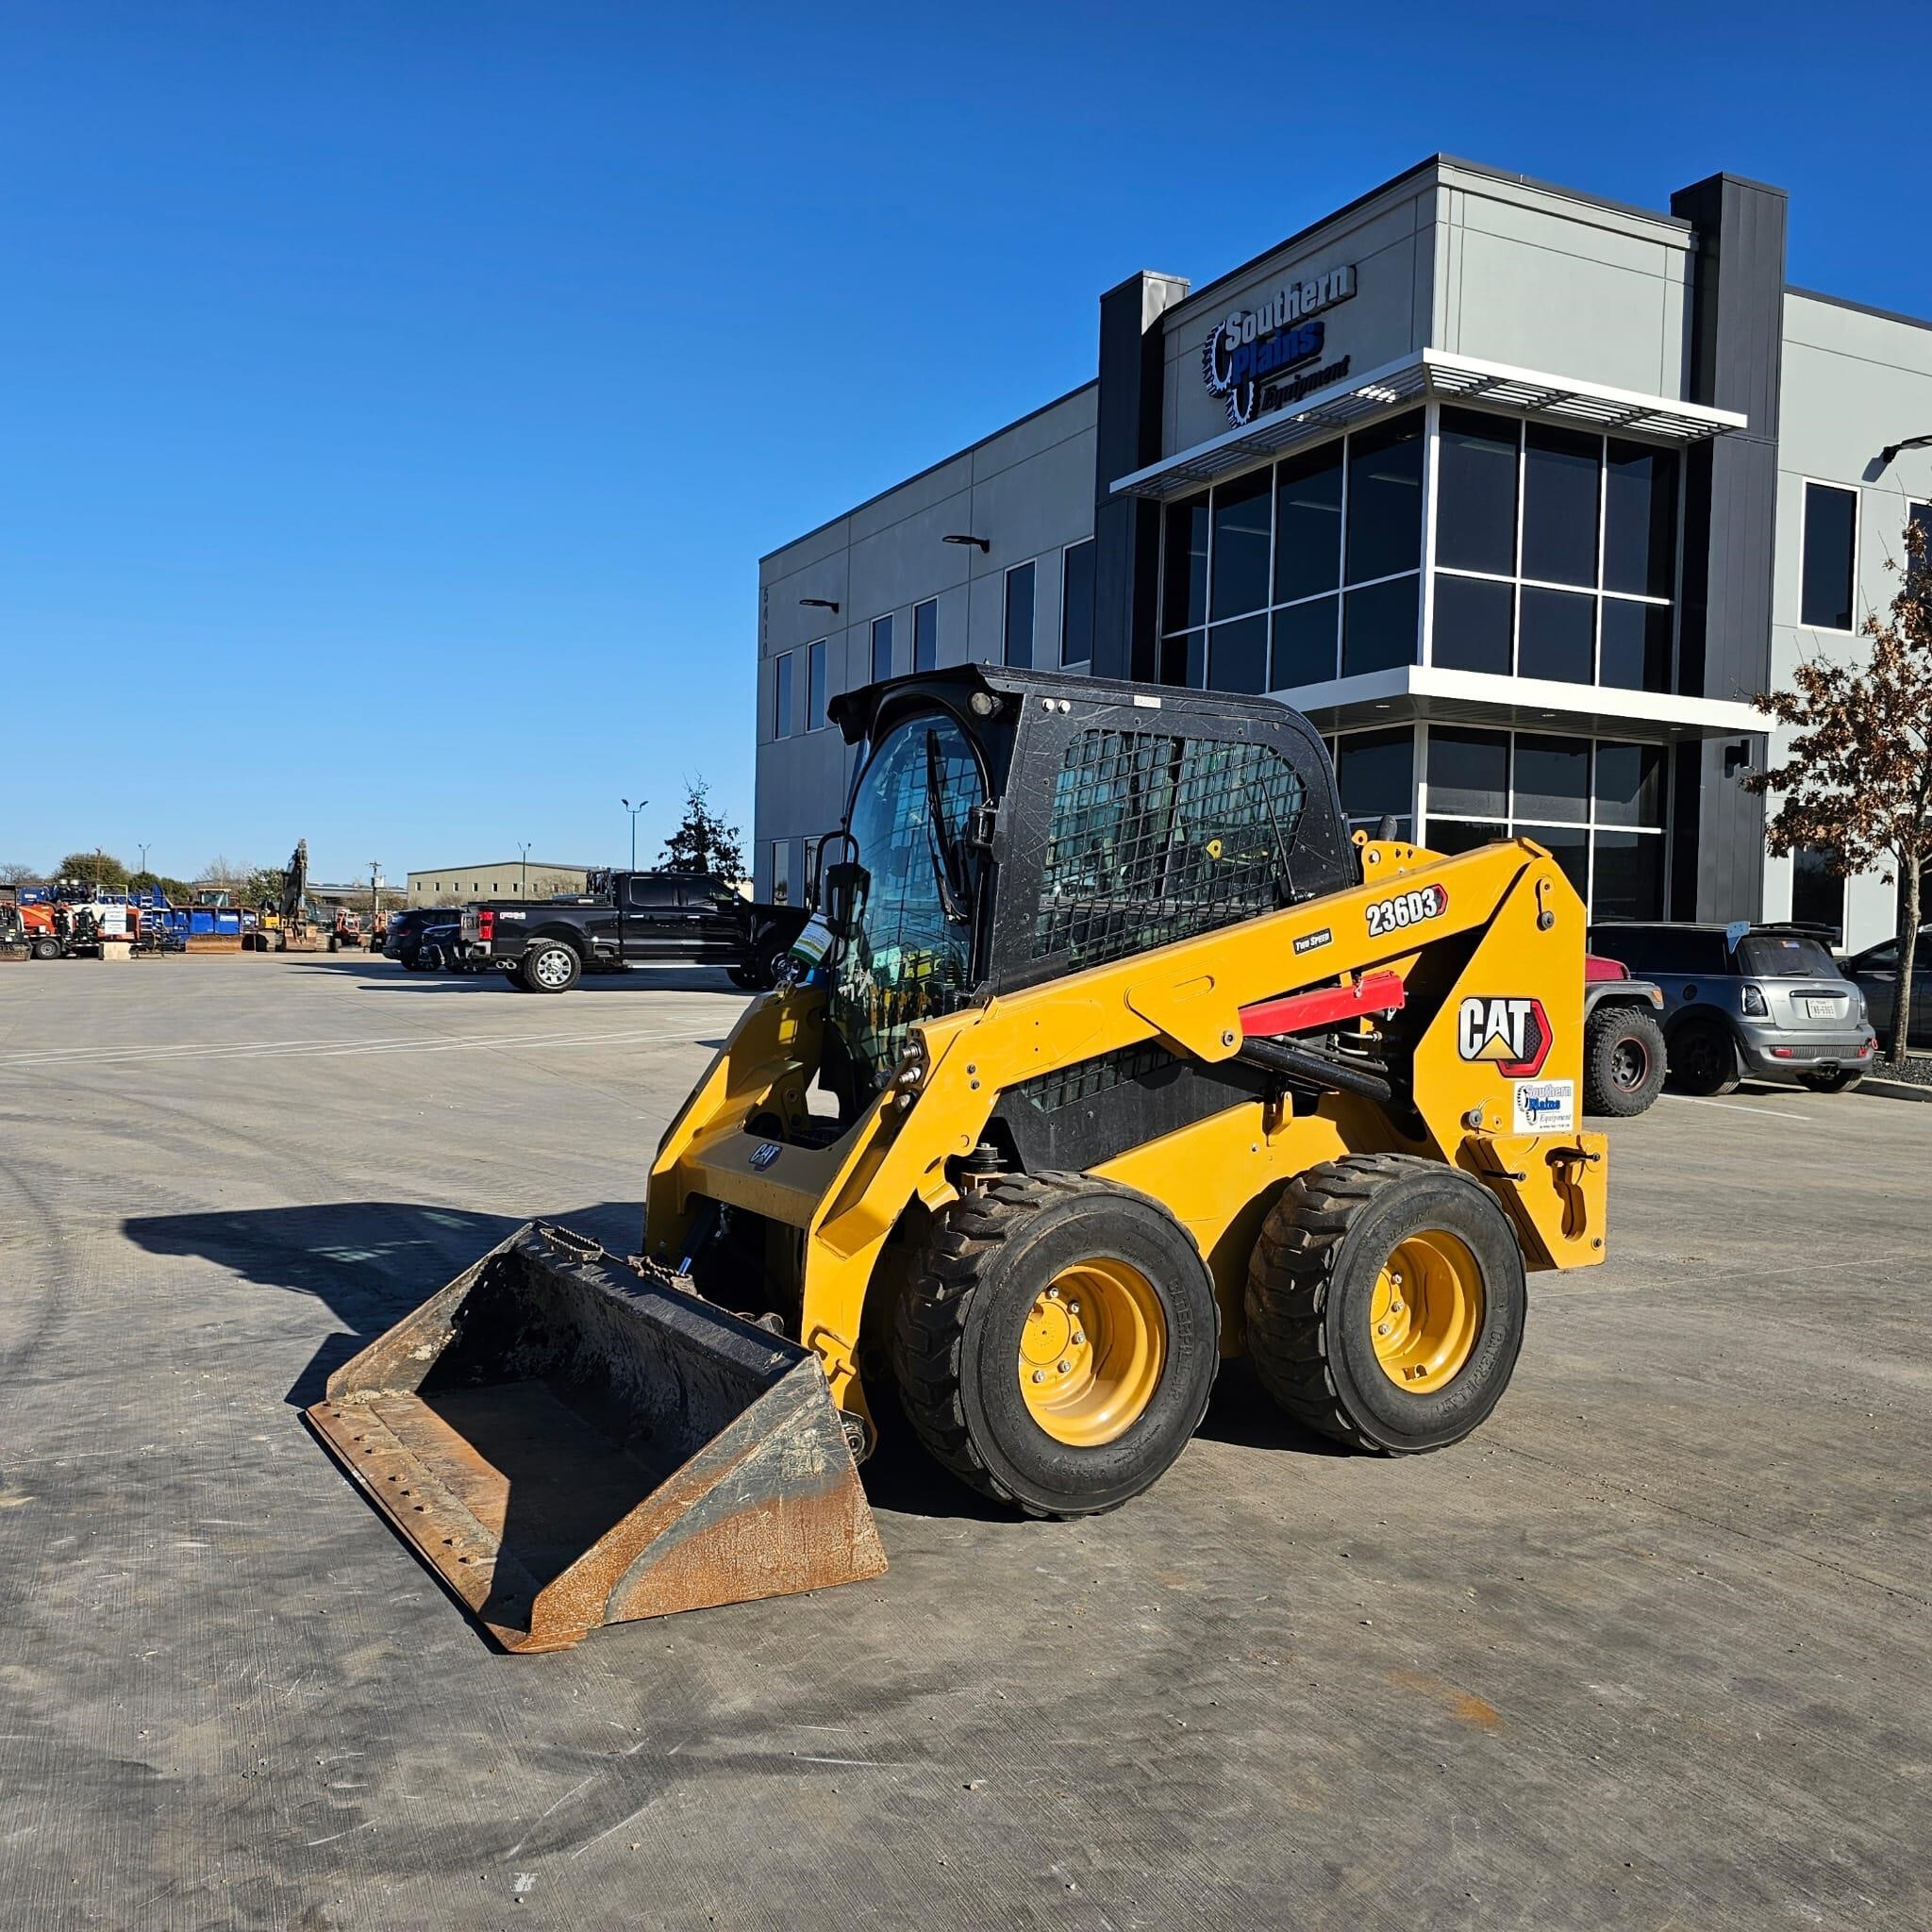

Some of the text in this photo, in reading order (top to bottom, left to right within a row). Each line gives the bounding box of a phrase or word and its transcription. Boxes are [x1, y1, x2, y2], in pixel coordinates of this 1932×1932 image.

[1225, 265, 1357, 351] Southern
[1231, 322, 1324, 385] Plains
[1261, 355, 1351, 411] Equipment
[1366, 888, 1437, 936] 236D3
[1459, 998, 1530, 1058] CAT
[1525, 1084, 1571, 1097] Southern
[1528, 1097, 1560, 1111] Plains
[1540, 1114, 1571, 1123] Equipment
[750, 1143, 780, 1165] CAT
